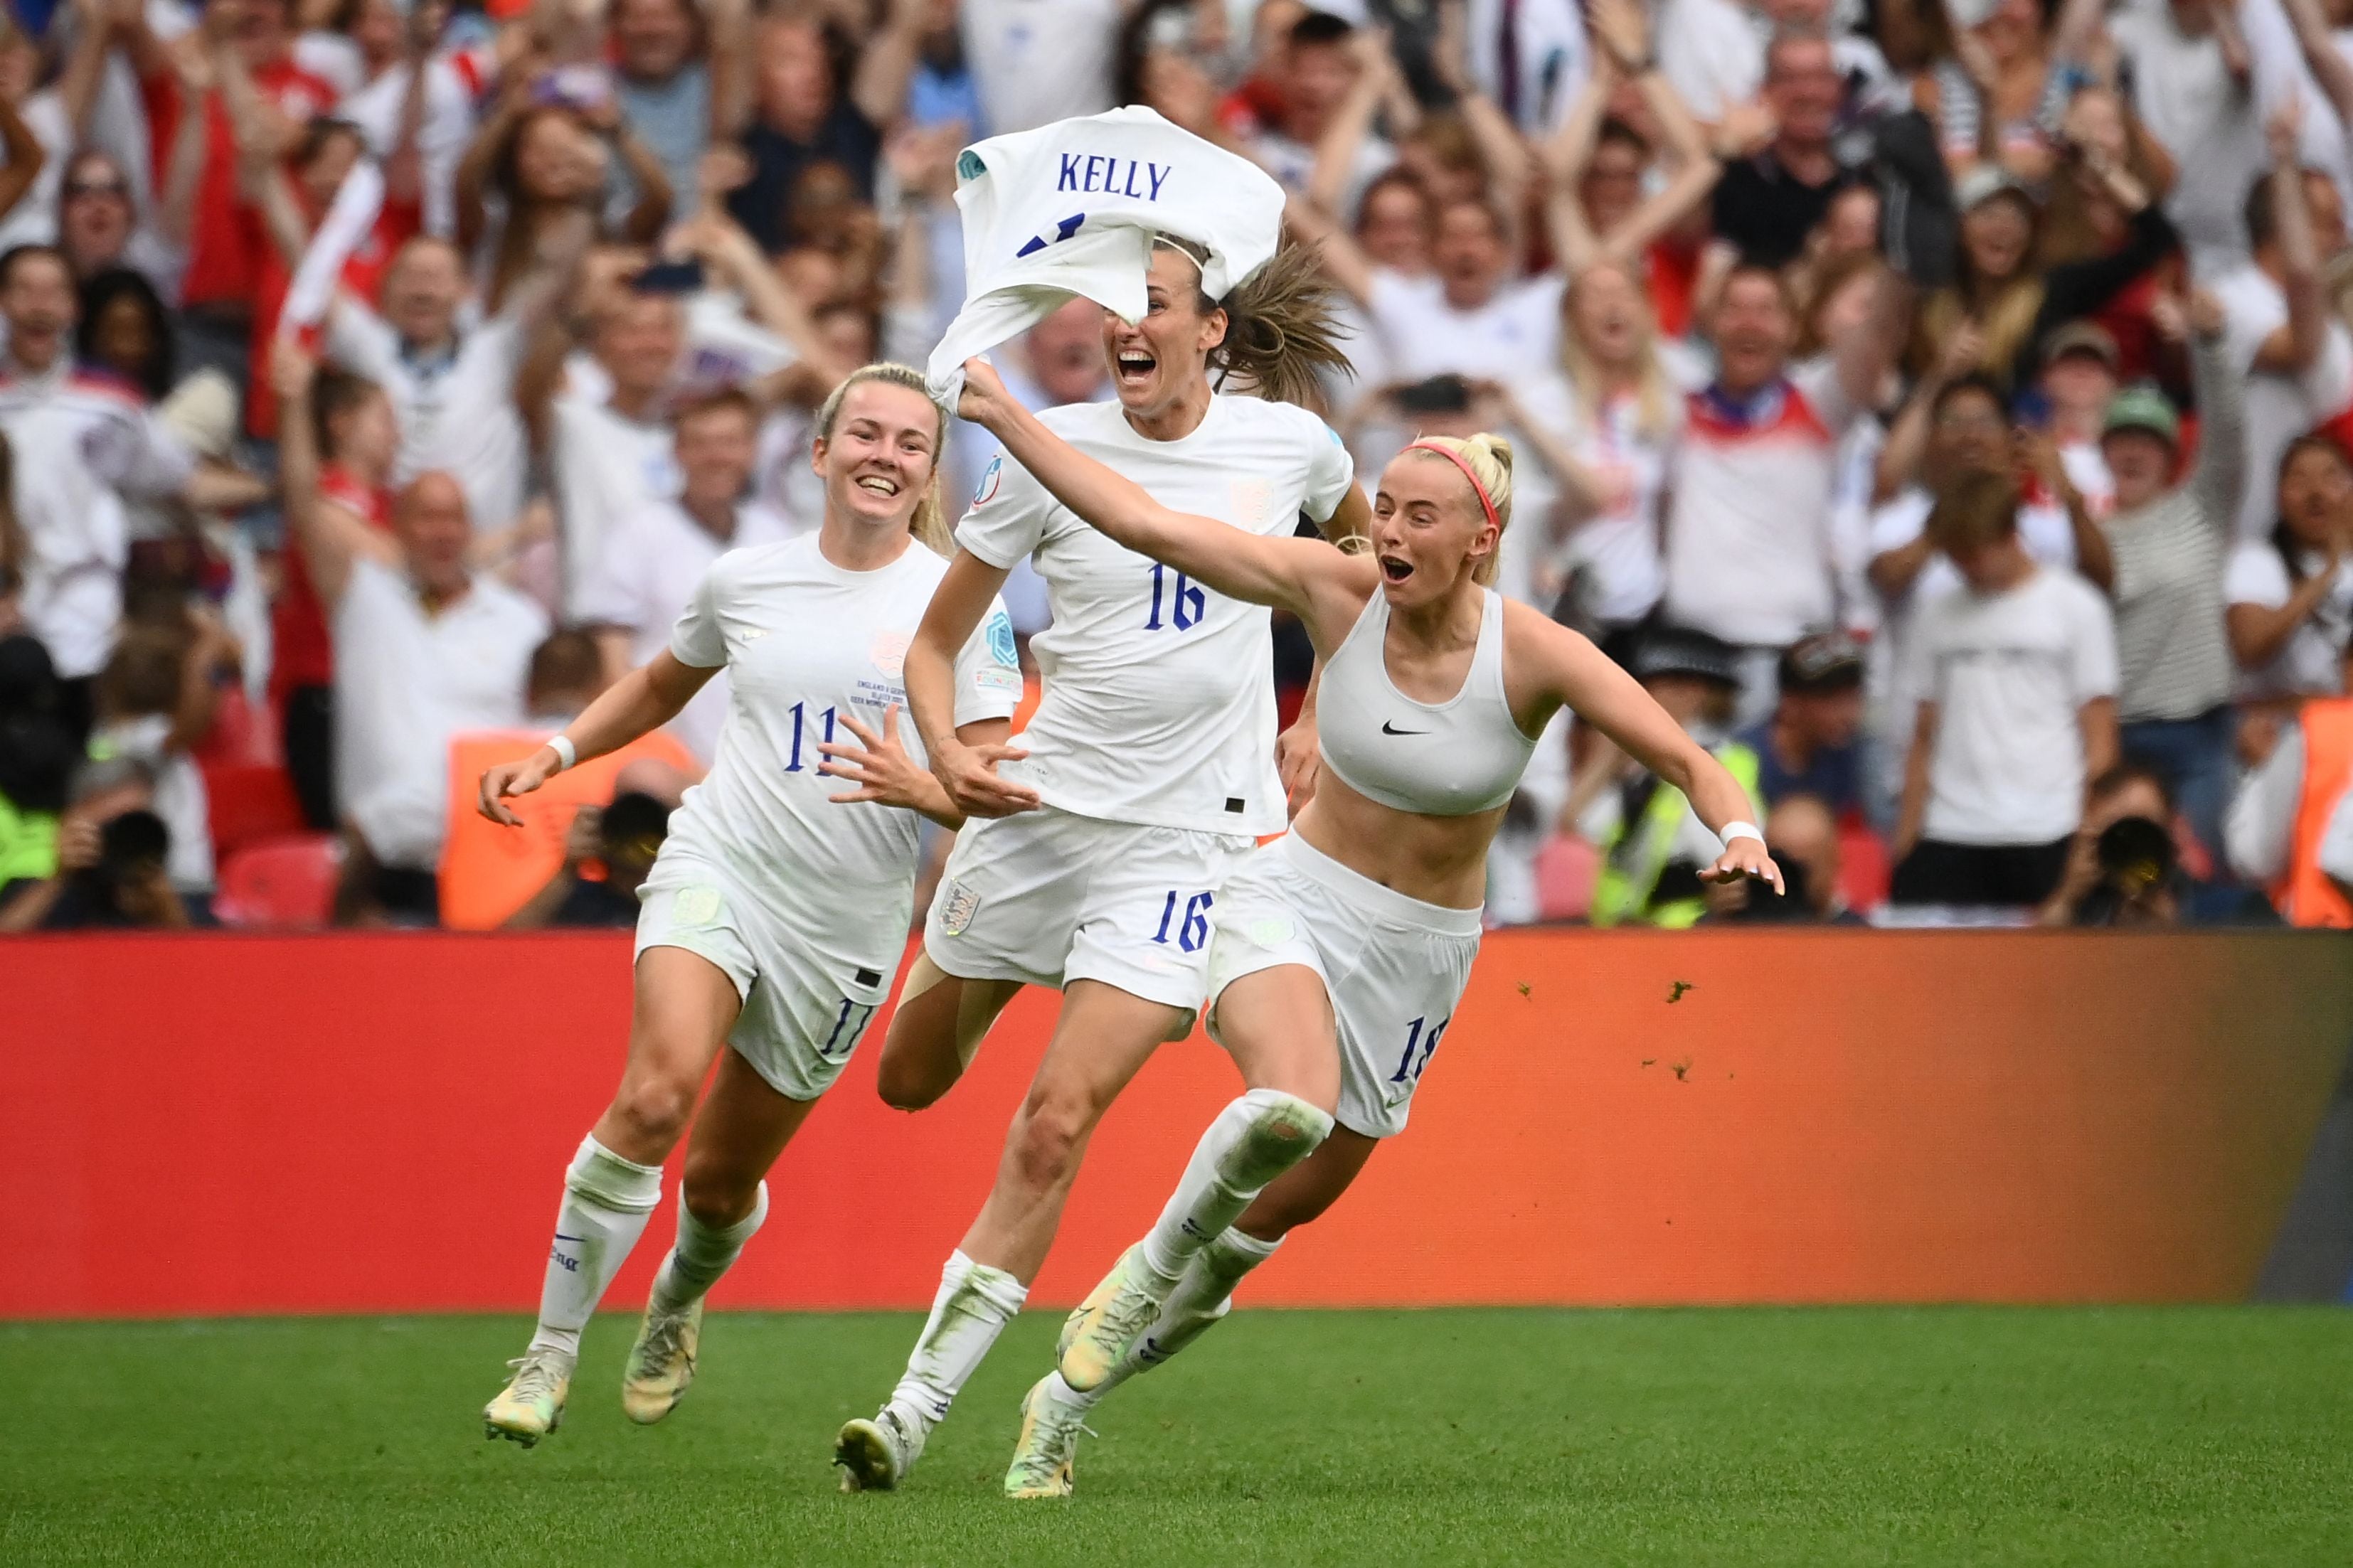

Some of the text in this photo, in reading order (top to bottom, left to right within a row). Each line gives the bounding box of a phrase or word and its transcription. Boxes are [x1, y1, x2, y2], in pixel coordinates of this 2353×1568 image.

[1057, 152, 1172, 202] KELLY
[1142, 562, 1206, 632] 16
[784, 700, 836, 777] 11
[1148, 890, 1213, 954] 16
[820, 997, 873, 1056] 11
